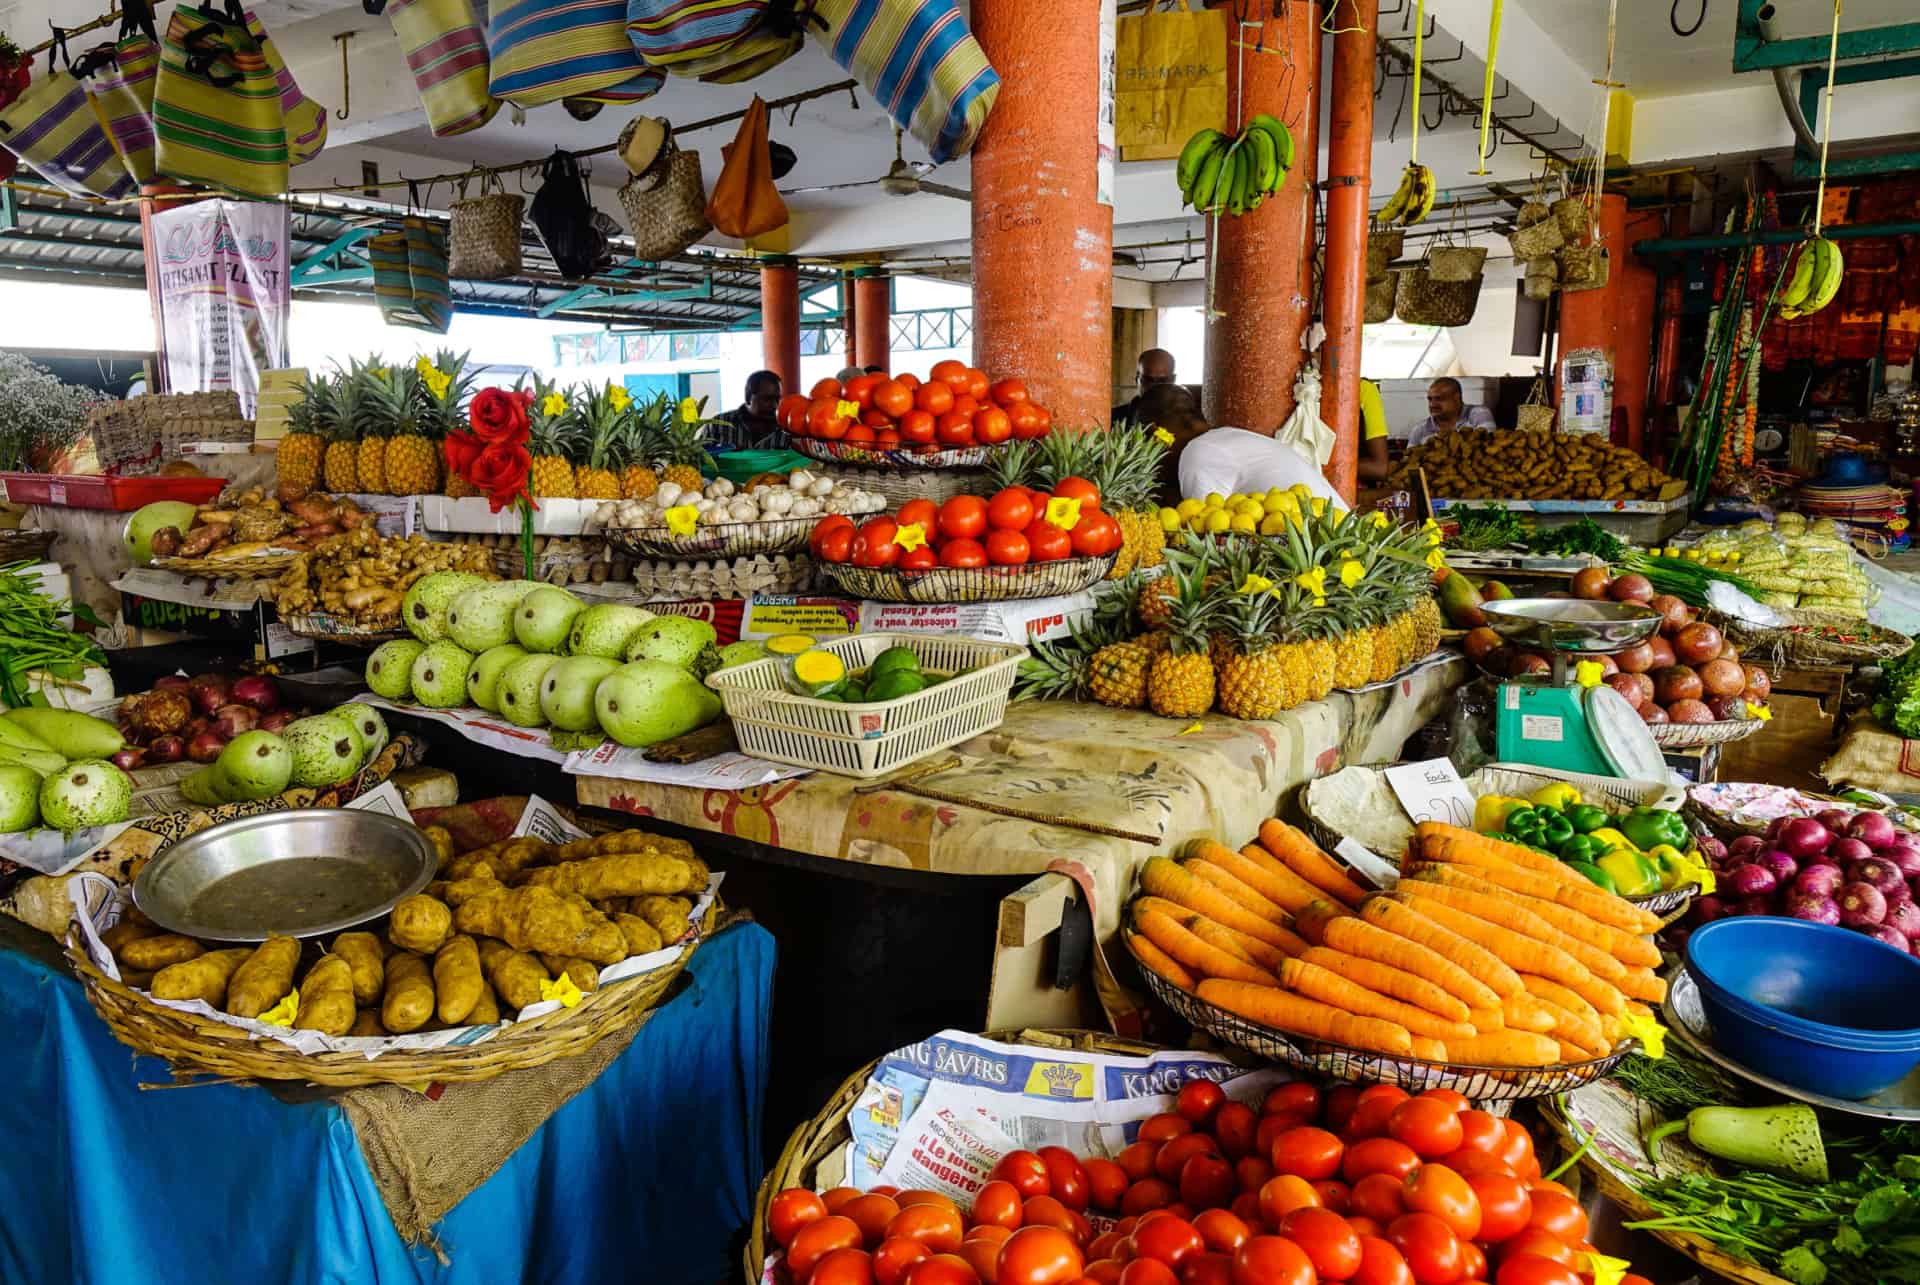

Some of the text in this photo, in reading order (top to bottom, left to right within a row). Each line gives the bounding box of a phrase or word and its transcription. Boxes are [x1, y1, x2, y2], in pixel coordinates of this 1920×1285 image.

[1126, 65, 1209, 80] PRIMARK
[163, 262, 218, 289] RTISANAT
[881, 606, 928, 616] d'Arsenal
[910, 618, 957, 629] Leicester
[934, 1042, 1008, 1085] SAVERS
[1121, 1068, 1181, 1098] KING
[928, 1138, 946, 1159] Le
